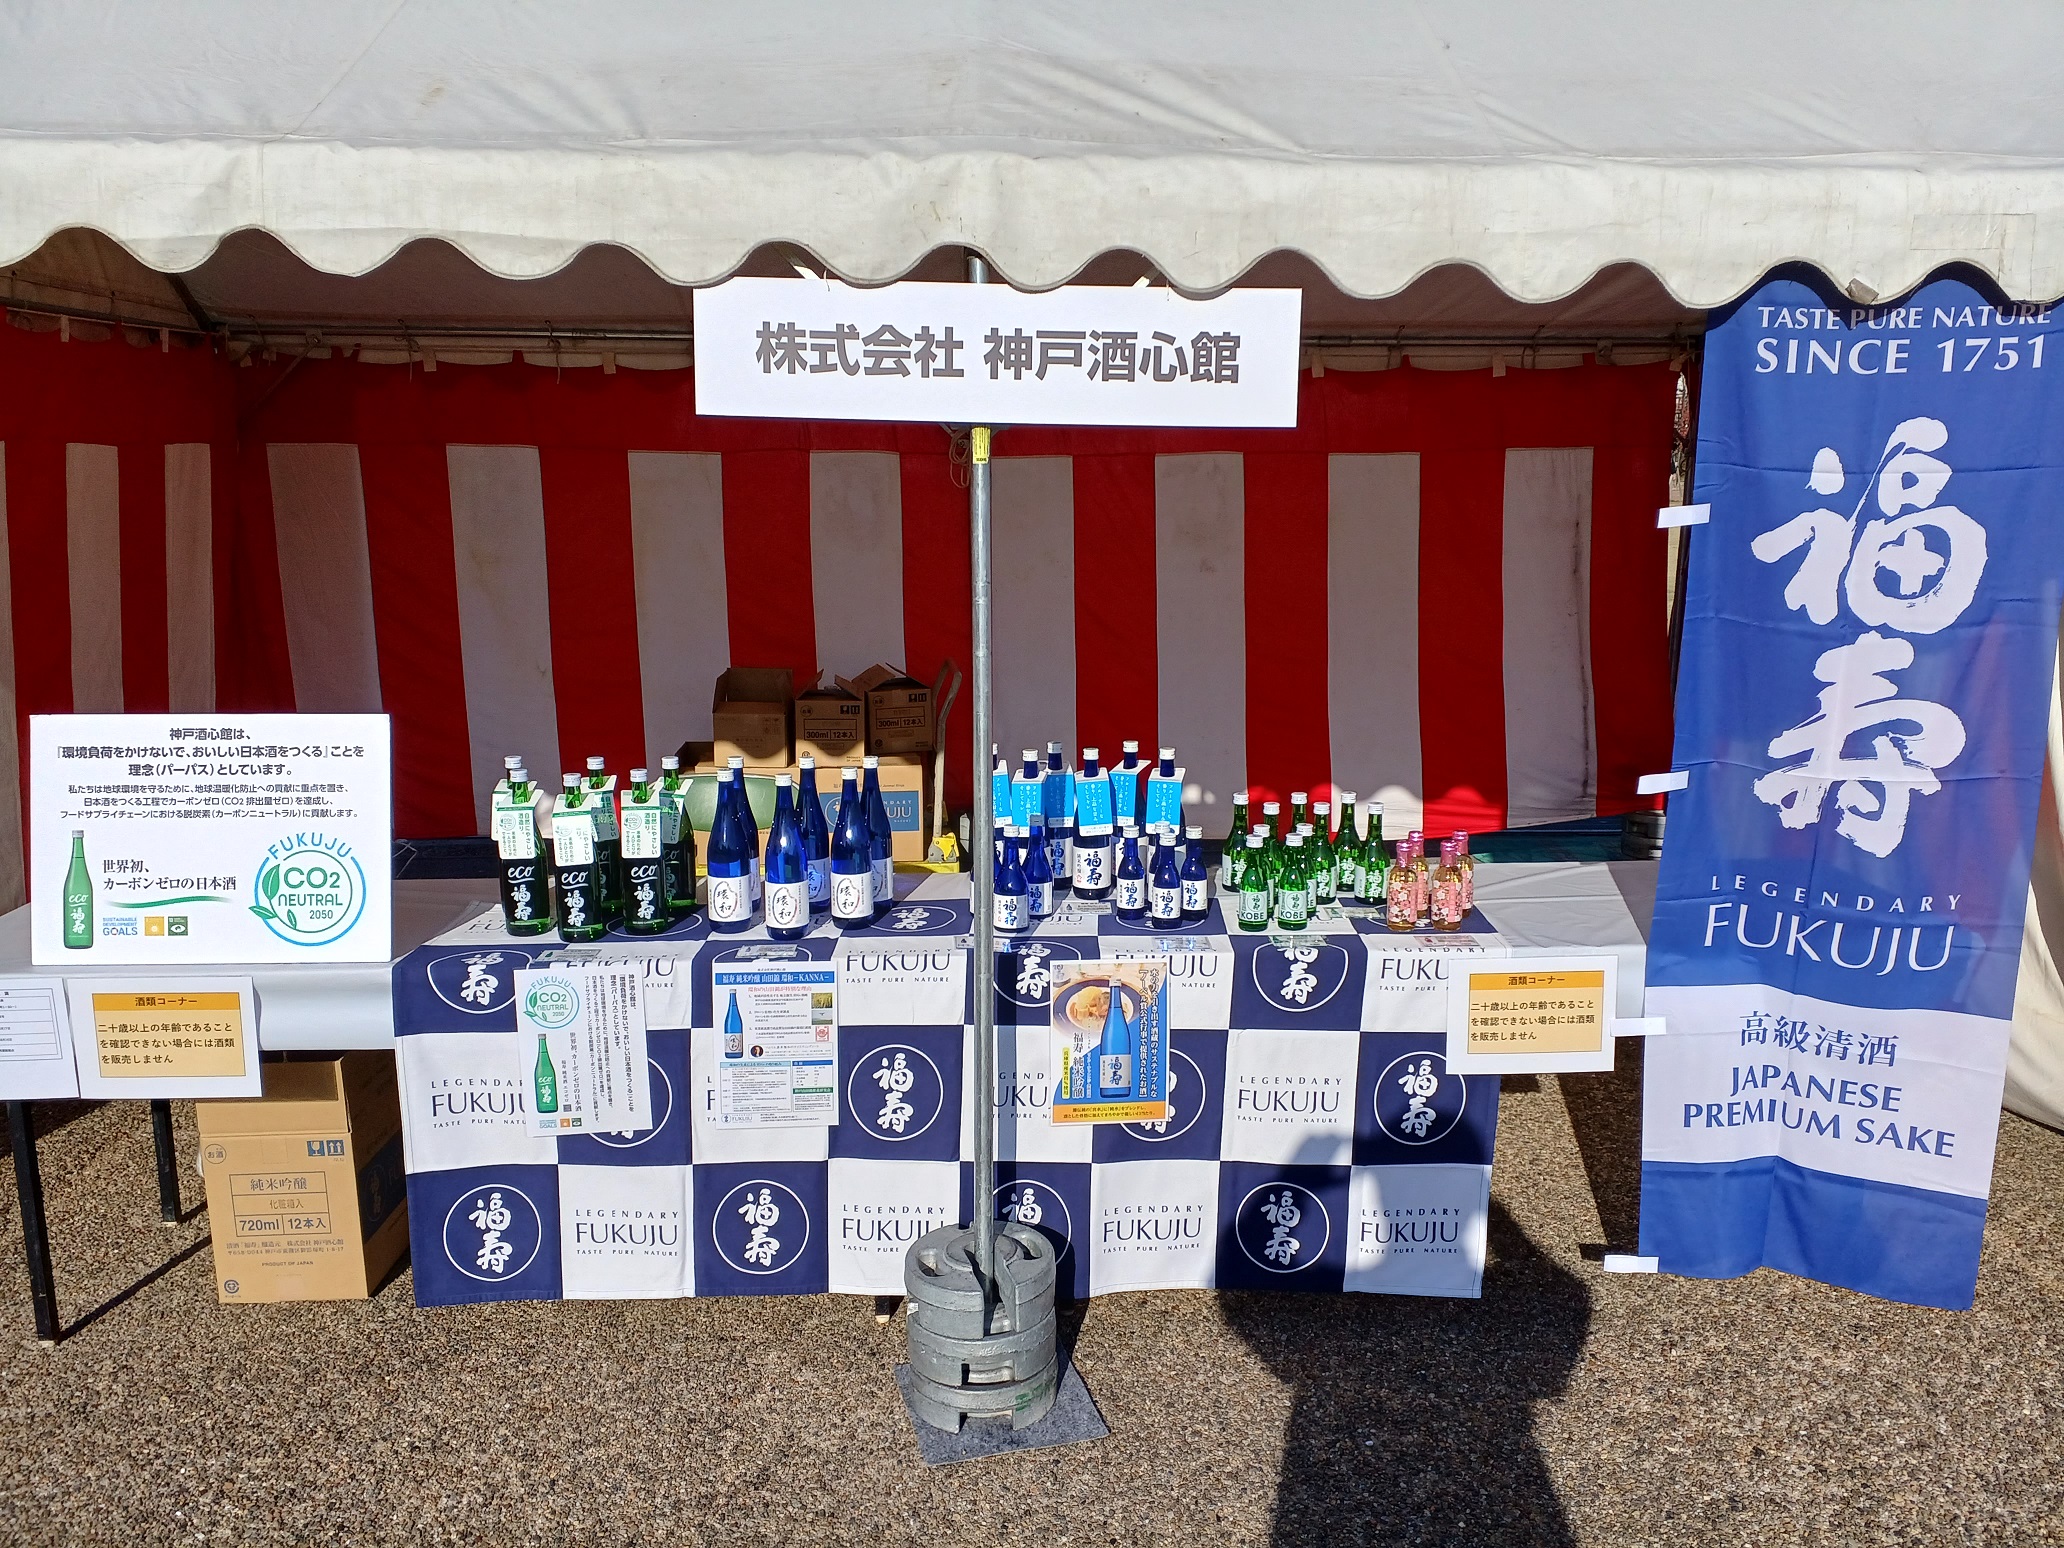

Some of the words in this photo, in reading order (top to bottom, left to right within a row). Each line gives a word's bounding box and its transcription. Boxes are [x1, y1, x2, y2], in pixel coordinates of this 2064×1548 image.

[1758, 306, 1840, 330] TASTE
[1849, 308, 1923, 330] PURE
[1932, 302, 2051, 328] NATURE
[755, 321, 964, 378] 株式会社
[983, 326, 1242, 384] 神戸酒心館
[1755, 337, 1911, 375] SINCE
[1937, 334, 2045, 373] 1751
[1750, 416, 1988, 858] 福寿
[878, 719, 900, 728] 300ml
[902, 718, 924, 726] 12本入
[169, 728, 252, 741] 神戸酒心館は、
[806, 731, 829, 739] 300ml
[832, 731, 855, 739] 12本入
[267, 832, 353, 860] FUKUJU
[102, 858, 150, 874] 世界初、
[507, 864, 535, 879] eco
[631, 864, 658, 877] eco
[1084, 850, 1102, 885] 福寿
[103, 876, 237, 892] カーボンゼロの日本酒
[283, 867, 341, 890] CO2
[561, 870, 589, 884] eco
[1366, 869, 1383, 898] 福寿
[277, 893, 344, 907] NEUTRAL
[1124, 881, 1138, 908] 福寿
[1185, 883, 1198, 908] 福寿
[1711, 874, 1962, 914] LEGENDARY
[1160, 890, 1174, 917] 福寿
[309, 910, 334, 920] 2050
[1003, 899, 1018, 926] 福寿
[1240, 911, 1264, 920] KOBE
[1280, 910, 1304, 919] KOBE
[102, 927, 138, 937] GOALS
[1703, 902, 1956, 977] FUKUJU
[846, 953, 951, 973] FUKUJU
[1381, 958, 1449, 980] FUKU
[531, 976, 572, 989] FUKUJU
[1508, 975, 1566, 986] 酒類コーナー
[135, 996, 198, 1007] 酒類コーナー
[539, 992, 567, 1003] CO2
[536, 1003, 569, 1011] NEUTRAL
[1470, 1000, 1595, 1012] 二十歳以上の年齢であること
[1470, 1014, 1595, 1027] を確認できない場合には酒類
[97, 1022, 233, 1034] 二十歳以上の年齢であること
[1470, 1030, 1538, 1042] を販売しません
[1738, 1010, 1900, 1068] 高級清酒
[99, 1037, 236, 1050] を確認できない場合には酒類
[101, 1053, 174, 1065] を販売しません
[431, 1078, 522, 1089] LEGENDA
[1239, 1075, 1342, 1086] LEGENDARY
[872, 1052, 915, 1133] 福寿
[1731, 1064, 1903, 1113] JAPANESE
[1238, 1089, 1340, 1114] FUKUJU
[1398, 1059, 1439, 1138] 福寿
[433, 1120, 461, 1128] TASTE
[1682, 1098, 1842, 1140] PREMIUM
[1855, 1117, 1956, 1159] SAKE
[574, 1209, 679, 1219] LEGENDARY
[843, 1204, 945, 1214] LEGENDARY
[1103, 1204, 1204, 1216] LEGENDARY
[1361, 1207, 1462, 1217] LEGENDARY
[239, 1219, 280, 1232] 720ml
[287, 1217, 327, 1230] 12本入
[738, 1187, 781, 1266] 福寿
[1102, 1217, 1202, 1242] FUKUJU
[1260, 1191, 1301, 1265] 福寿
[469, 1192, 514, 1275] 福寿
[574, 1222, 679, 1245] FUKUJU
[1360, 1221, 1460, 1244] FUKUJU
[644, 1248, 679, 1257] NATURE
[1103, 1246, 1125, 1254] TASTE
[1167, 1243, 1200, 1251] NATURE
